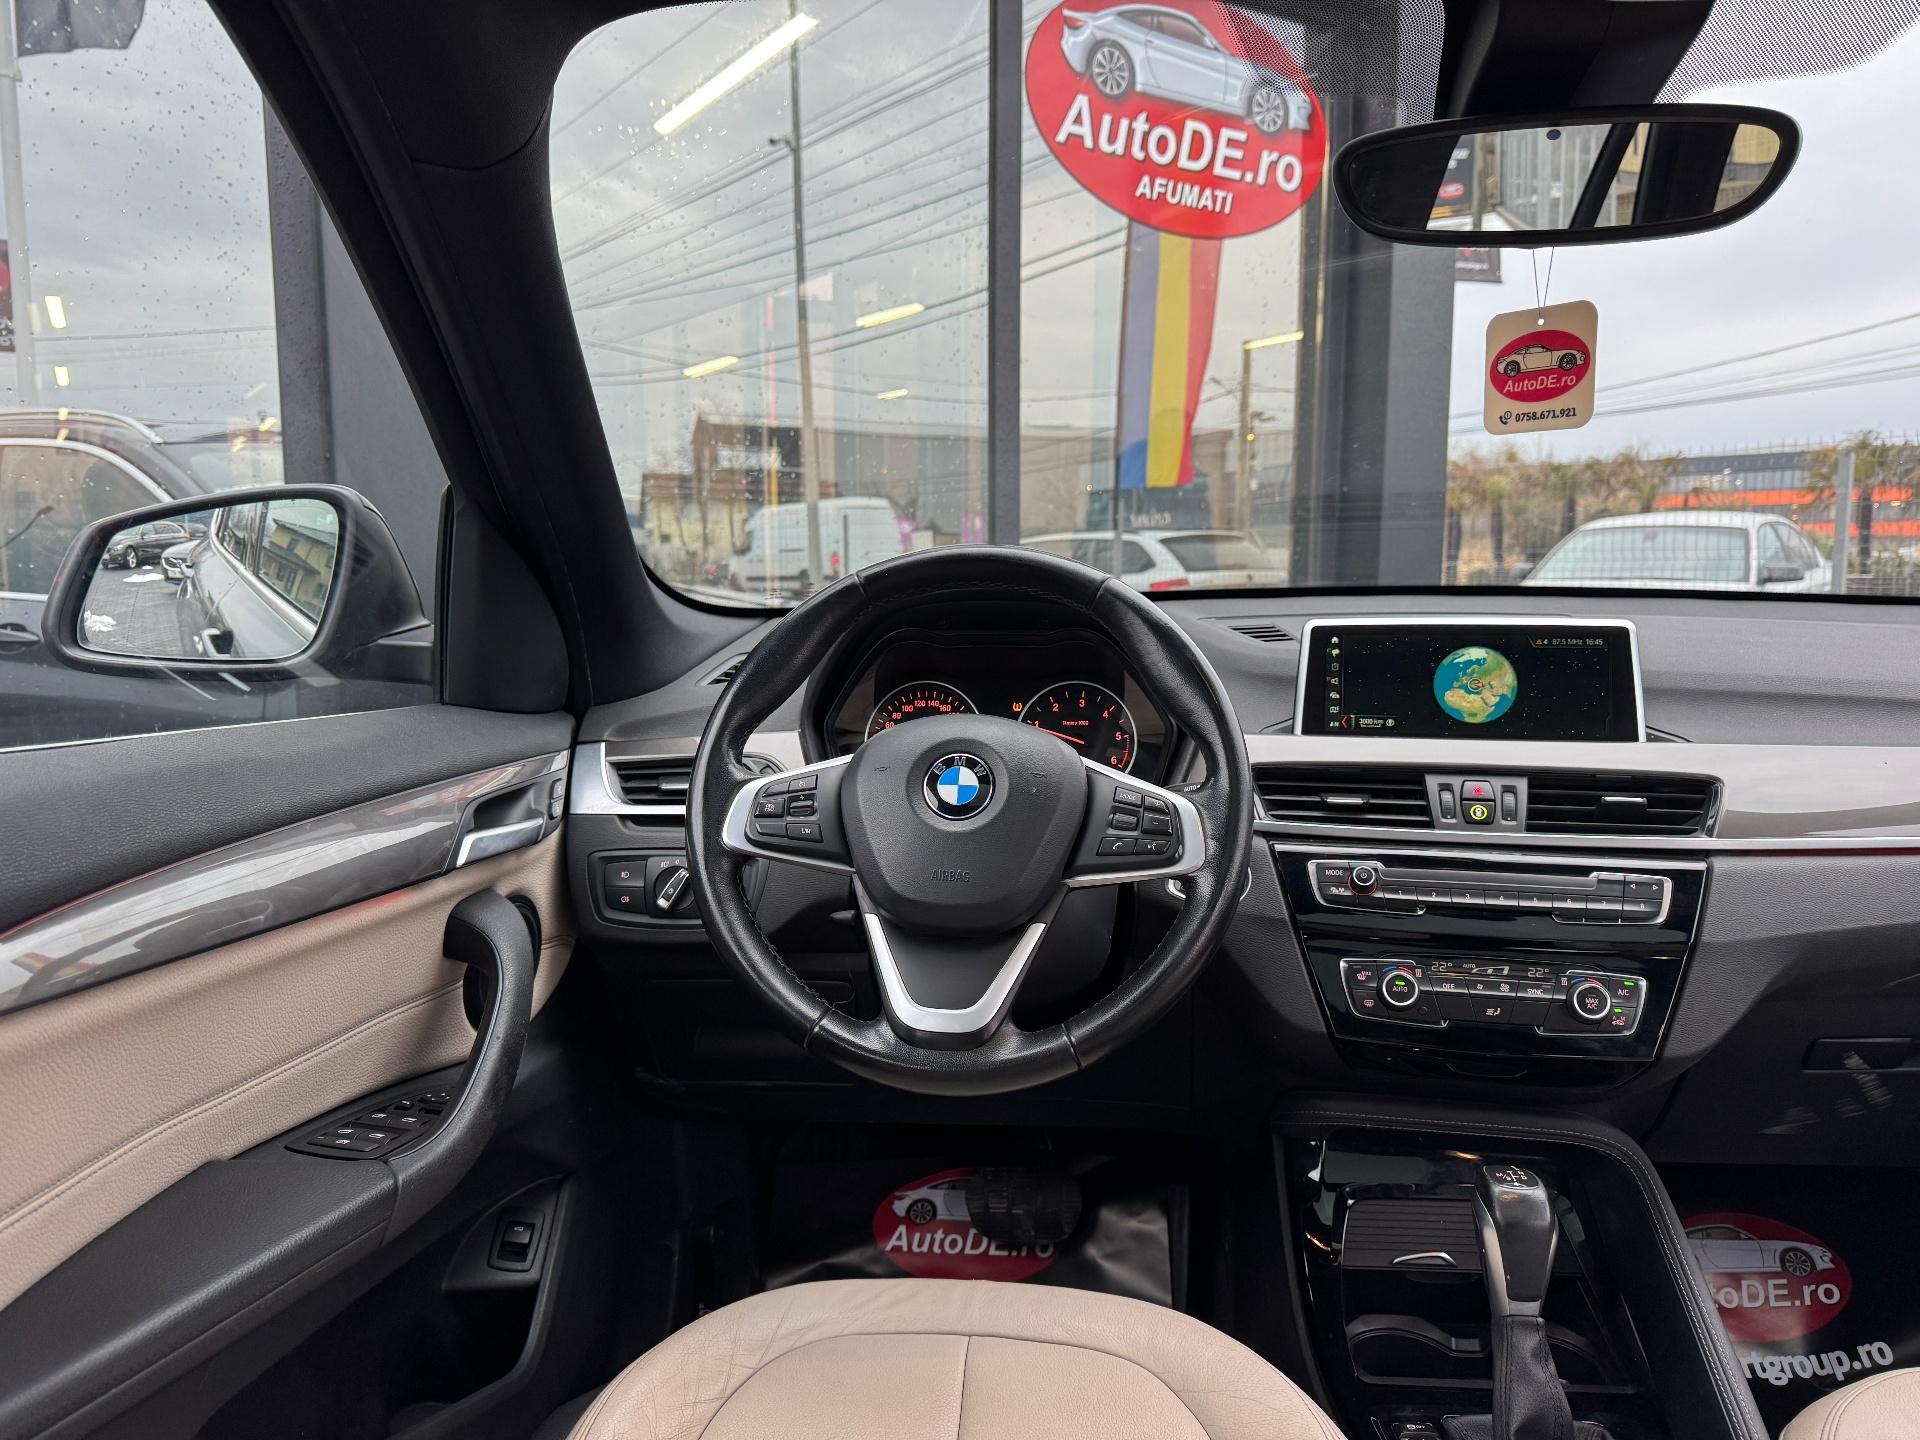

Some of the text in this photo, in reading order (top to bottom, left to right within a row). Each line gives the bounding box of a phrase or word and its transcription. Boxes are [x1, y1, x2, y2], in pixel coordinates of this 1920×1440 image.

[1055, 93, 1303, 192] AutoDE.ro
[1135, 175, 1233, 215] AFUMATI
[1503, 374, 1577, 393] AutoDE.ro
[1515, 407, 1577, 422] 0758.671.921
[1586, 638, 1604, 646] 16:45
[940, 704, 952, 712] 160
[1052, 703, 1059, 712] 2
[1079, 699, 1086, 708] 3
[892, 712, 902, 720] 80
[1102, 710, 1109, 719] 4
[885, 721, 895, 729] 60
[1034, 720, 1039, 728] 1
[1115, 732, 1122, 741] 5
[1110, 756, 1117, 765] 6
[933, 756, 987, 777] BMW
[930, 868, 971, 883] AIRBAG
[1392, 985, 1407, 993] AUTO
[1527, 988, 1543, 996] SYNC
[1617, 988, 1629, 996] A/C
[1585, 997, 1599, 1005] MAX
